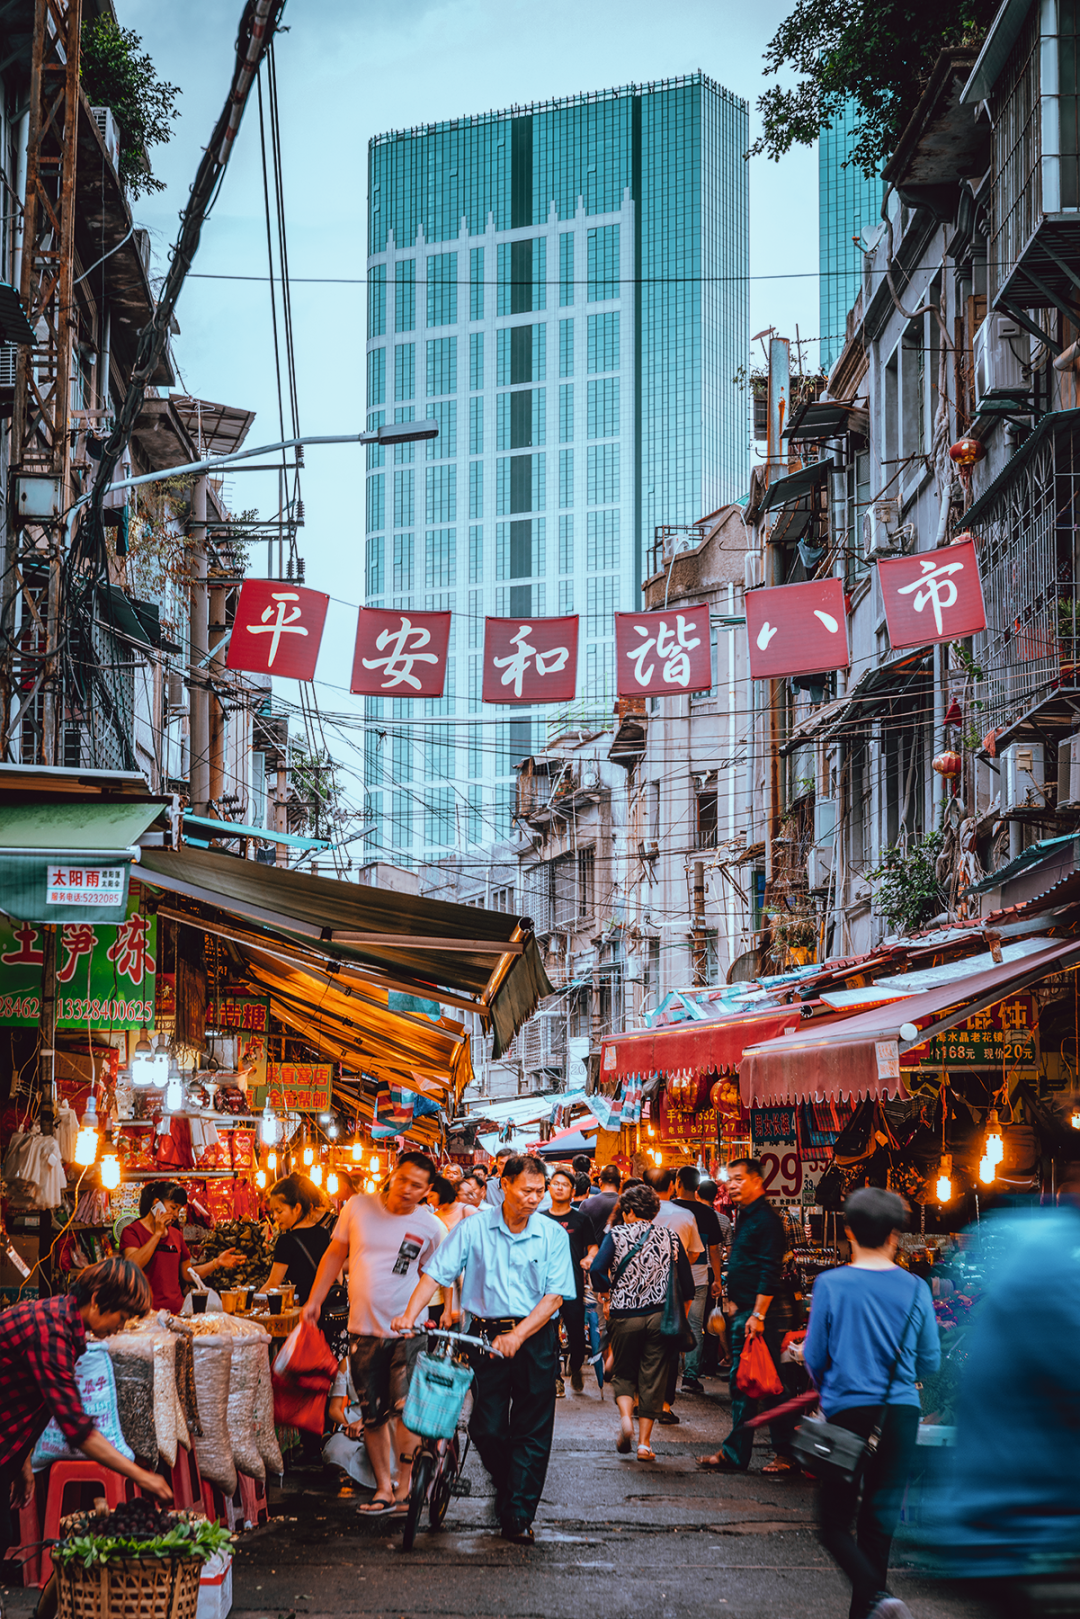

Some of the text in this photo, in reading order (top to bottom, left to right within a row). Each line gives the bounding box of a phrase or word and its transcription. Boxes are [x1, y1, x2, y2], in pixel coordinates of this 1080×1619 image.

[52, 869, 100, 888] 太阳雨
[57, 997, 153, 1022] 13328400625
[930, 1032, 1004, 1043] 海水晶老花镜
[269, 1089, 328, 1108] 全国帮邮
[690, 1123, 735, 1134] 827517
[760, 1152, 803, 1197] 29
